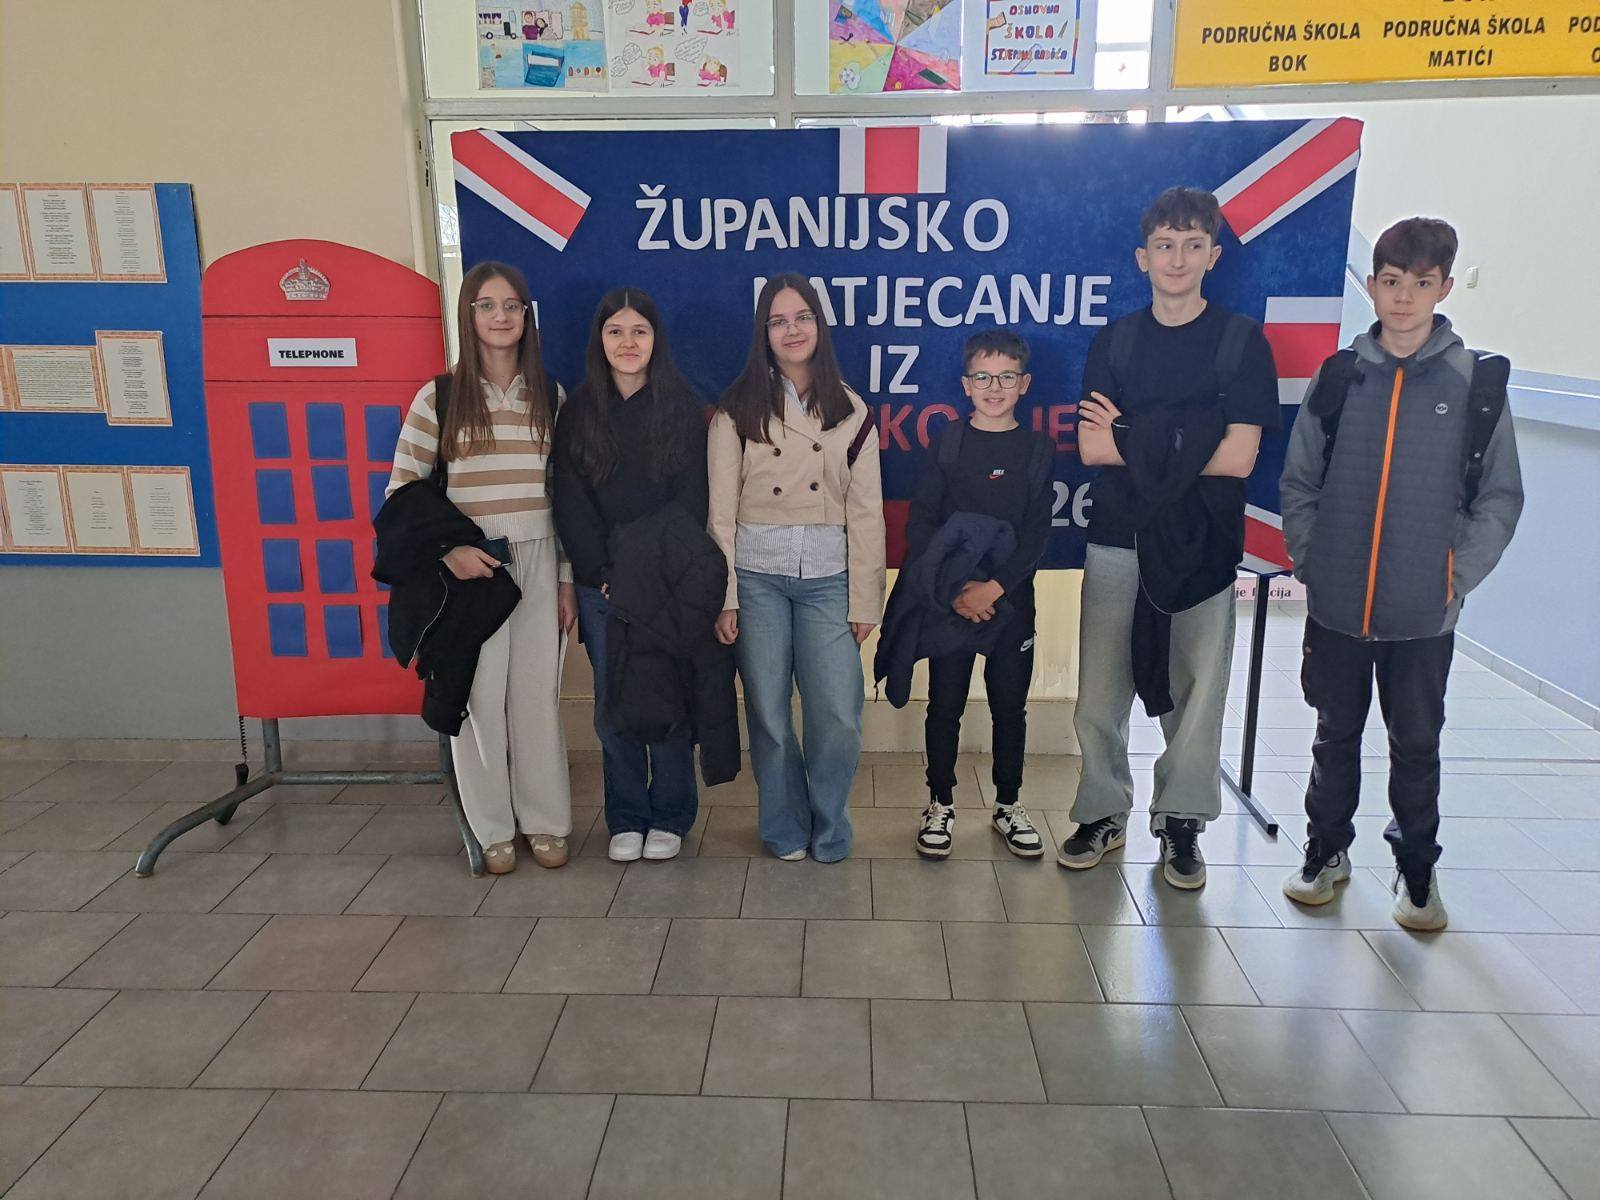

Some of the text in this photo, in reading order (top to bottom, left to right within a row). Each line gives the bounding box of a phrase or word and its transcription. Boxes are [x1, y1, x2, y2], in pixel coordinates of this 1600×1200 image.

[1009, 4, 1060, 16] OSNOVNA
[1003, 22, 1054, 39] ŠKOLA
[1202, 18, 1361, 44] PODRUČNA ŠKOLA
[1383, 14, 1546, 38] PODRUČNA ŠKOLA
[1268, 54, 1307, 72] BOK
[1428, 45, 1493, 67] MATIĆI
[635, 184, 1009, 253] ŽUPANIJSKO
[753, 273, 1112, 327] ATJECANJE
[278, 350, 345, 359] TELEPHONE
[869, 344, 920, 394] IZ
